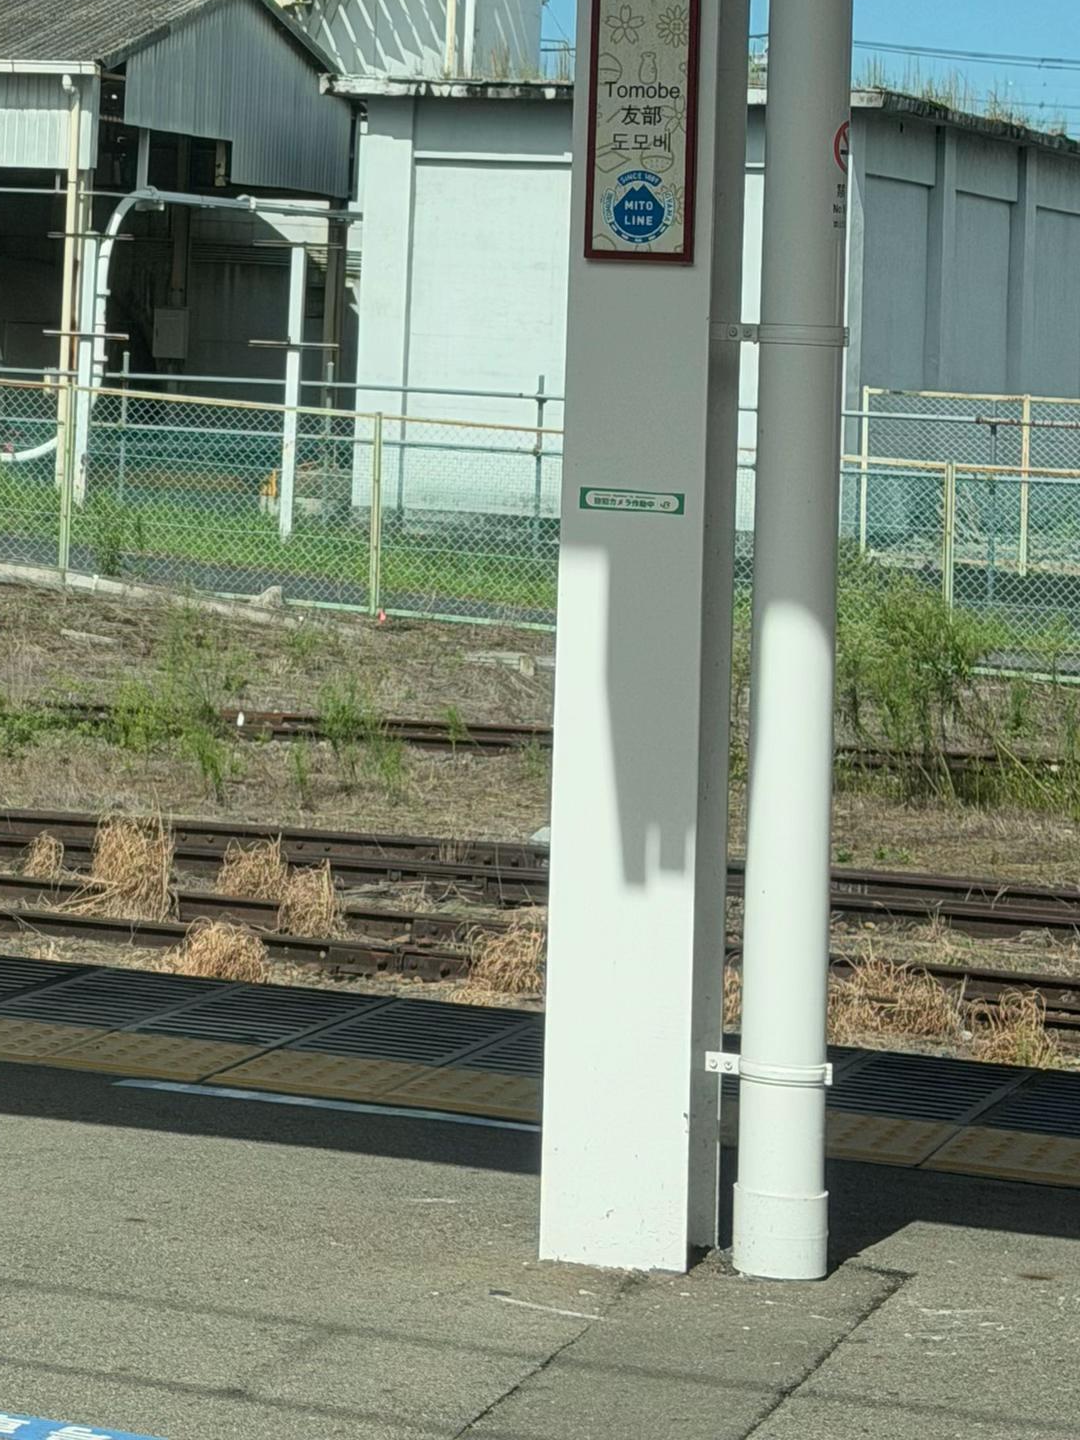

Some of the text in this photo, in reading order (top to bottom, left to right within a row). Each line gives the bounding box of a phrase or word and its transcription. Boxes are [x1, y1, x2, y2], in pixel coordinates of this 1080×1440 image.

[604, 81, 681, 100] Tomobe
[621, 104, 662, 127] 友部
[610, 128, 672, 153] 도모베
[624, 200, 654, 211] MITO
[624, 215, 653, 226] LINE
